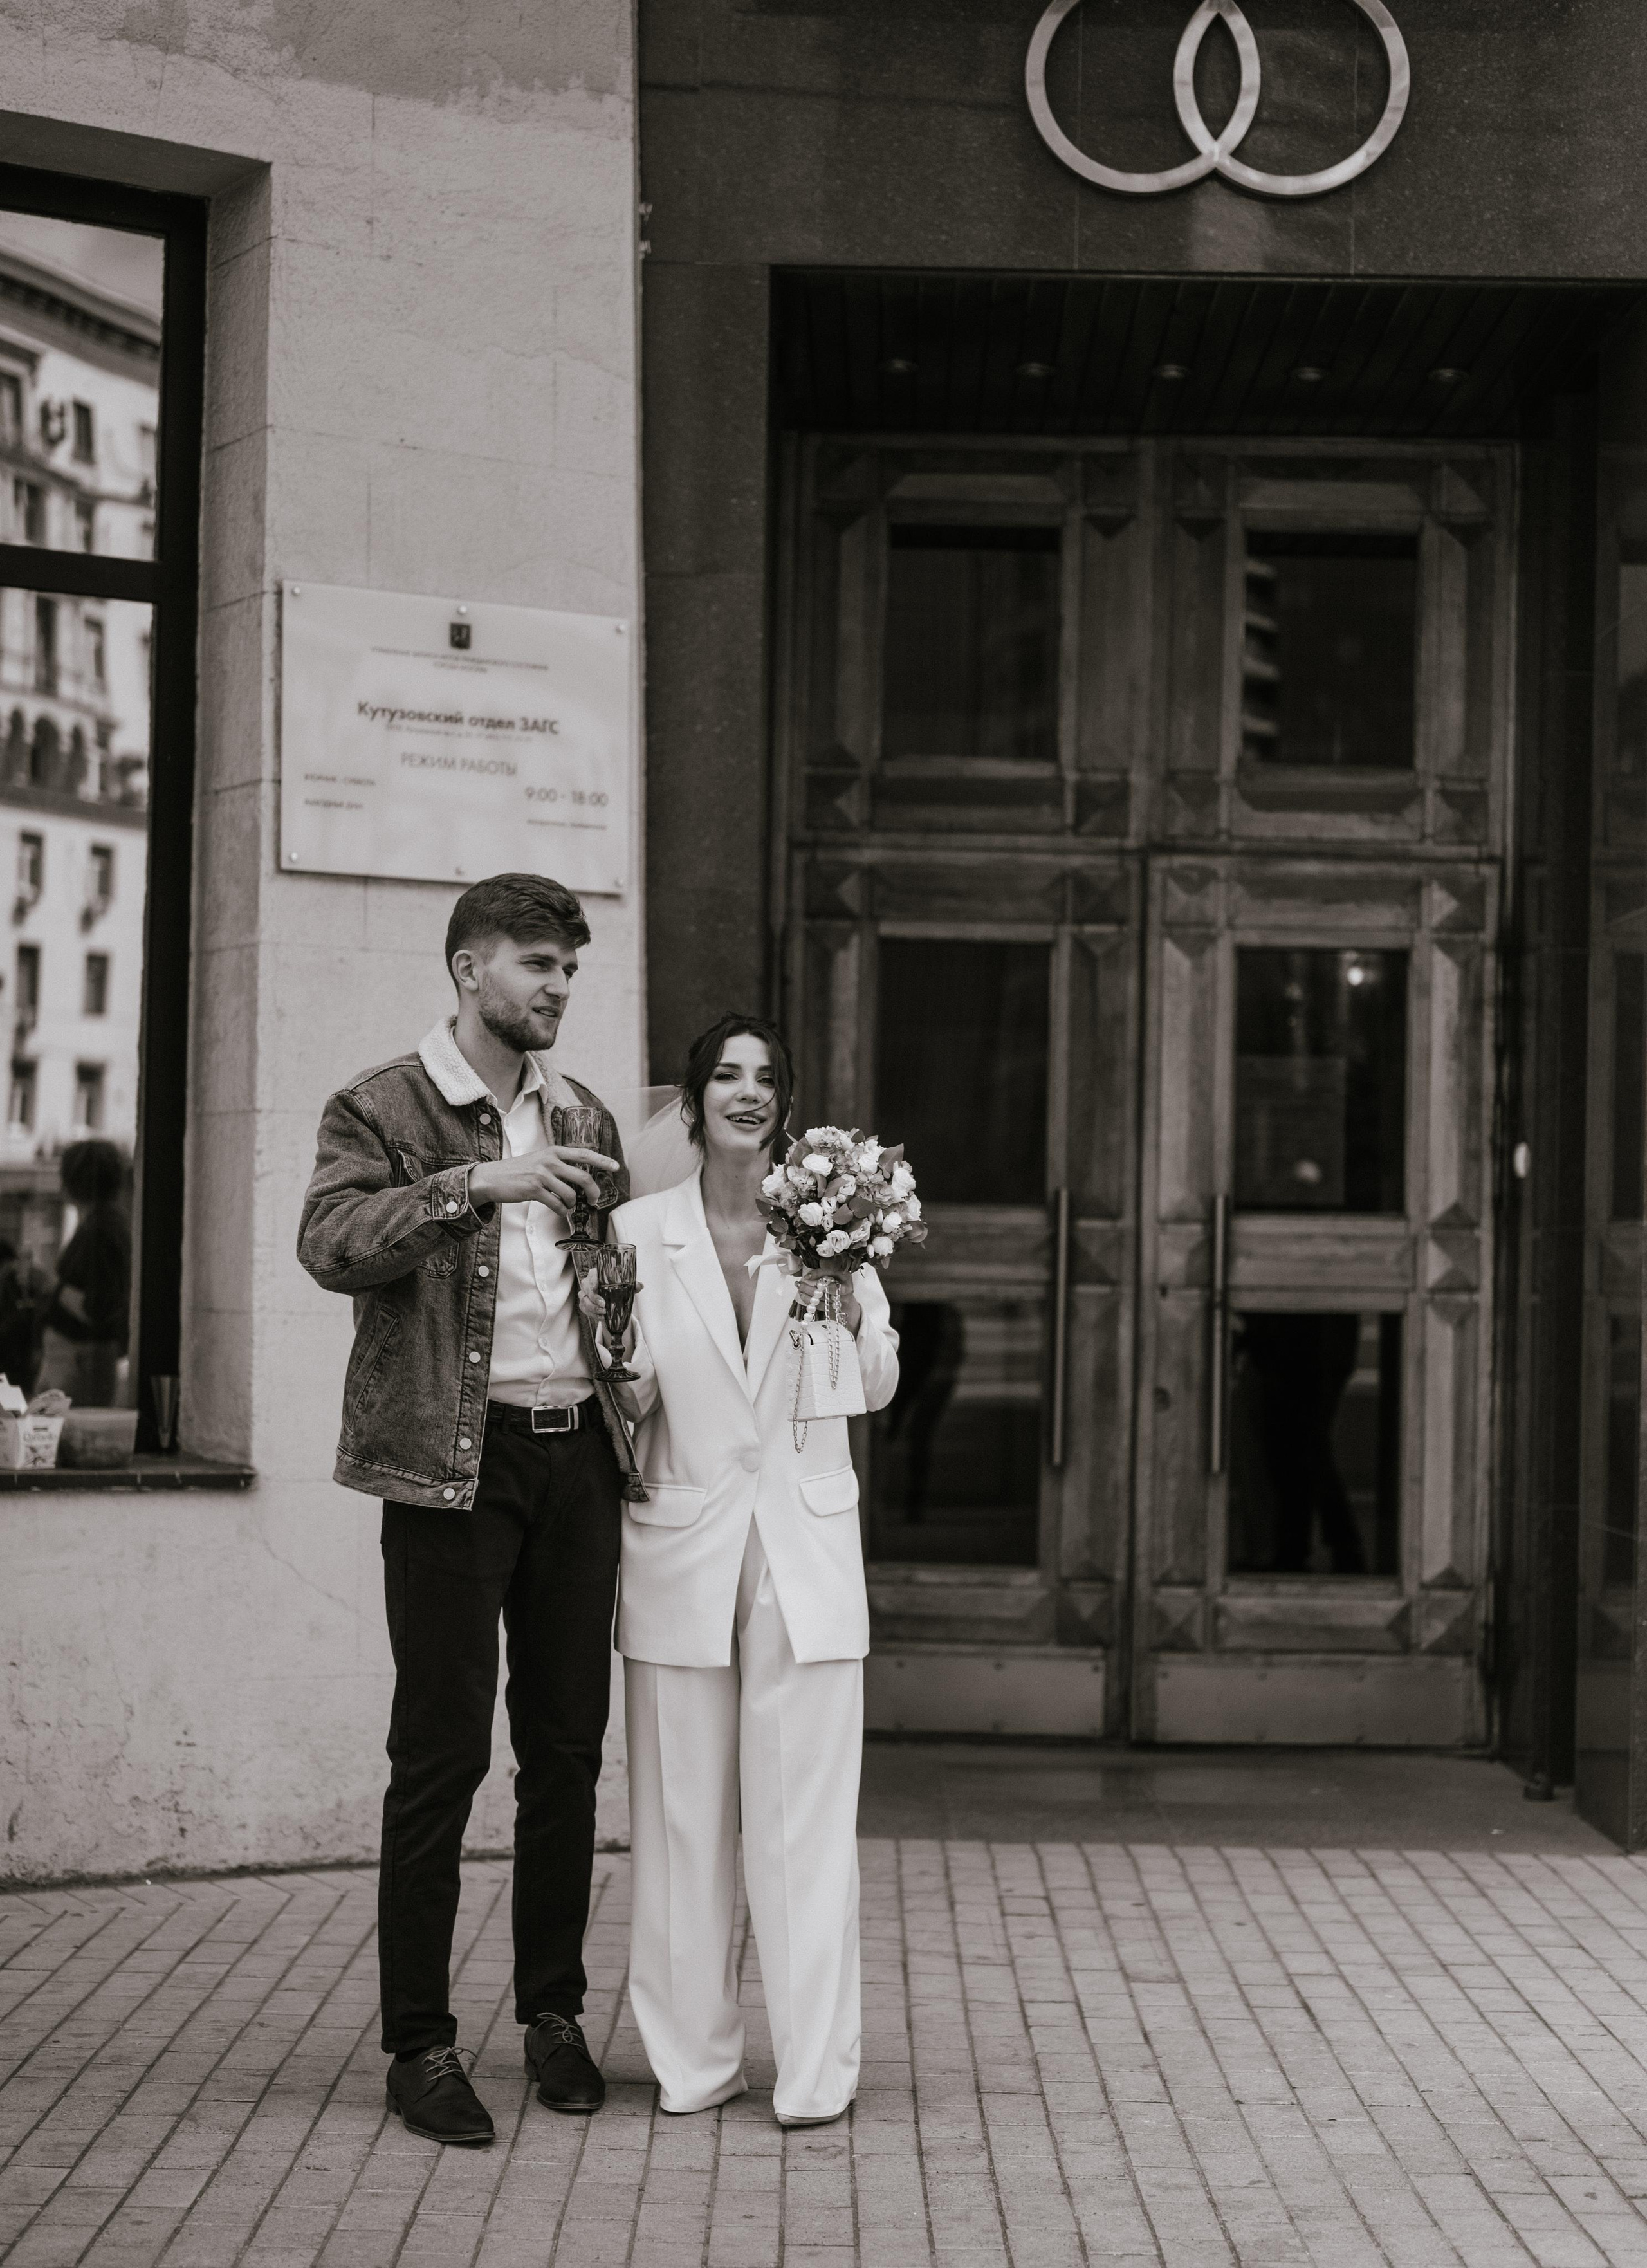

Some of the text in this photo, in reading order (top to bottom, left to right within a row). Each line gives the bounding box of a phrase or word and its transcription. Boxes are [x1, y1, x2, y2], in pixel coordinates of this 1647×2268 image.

[358, 701, 463, 724] Кутузовский
[468, 715, 515, 730] отдел
[519, 717, 560, 735] ЗАГС
[401, 752, 518, 777] РЕЖИМ РАБОТЫ
